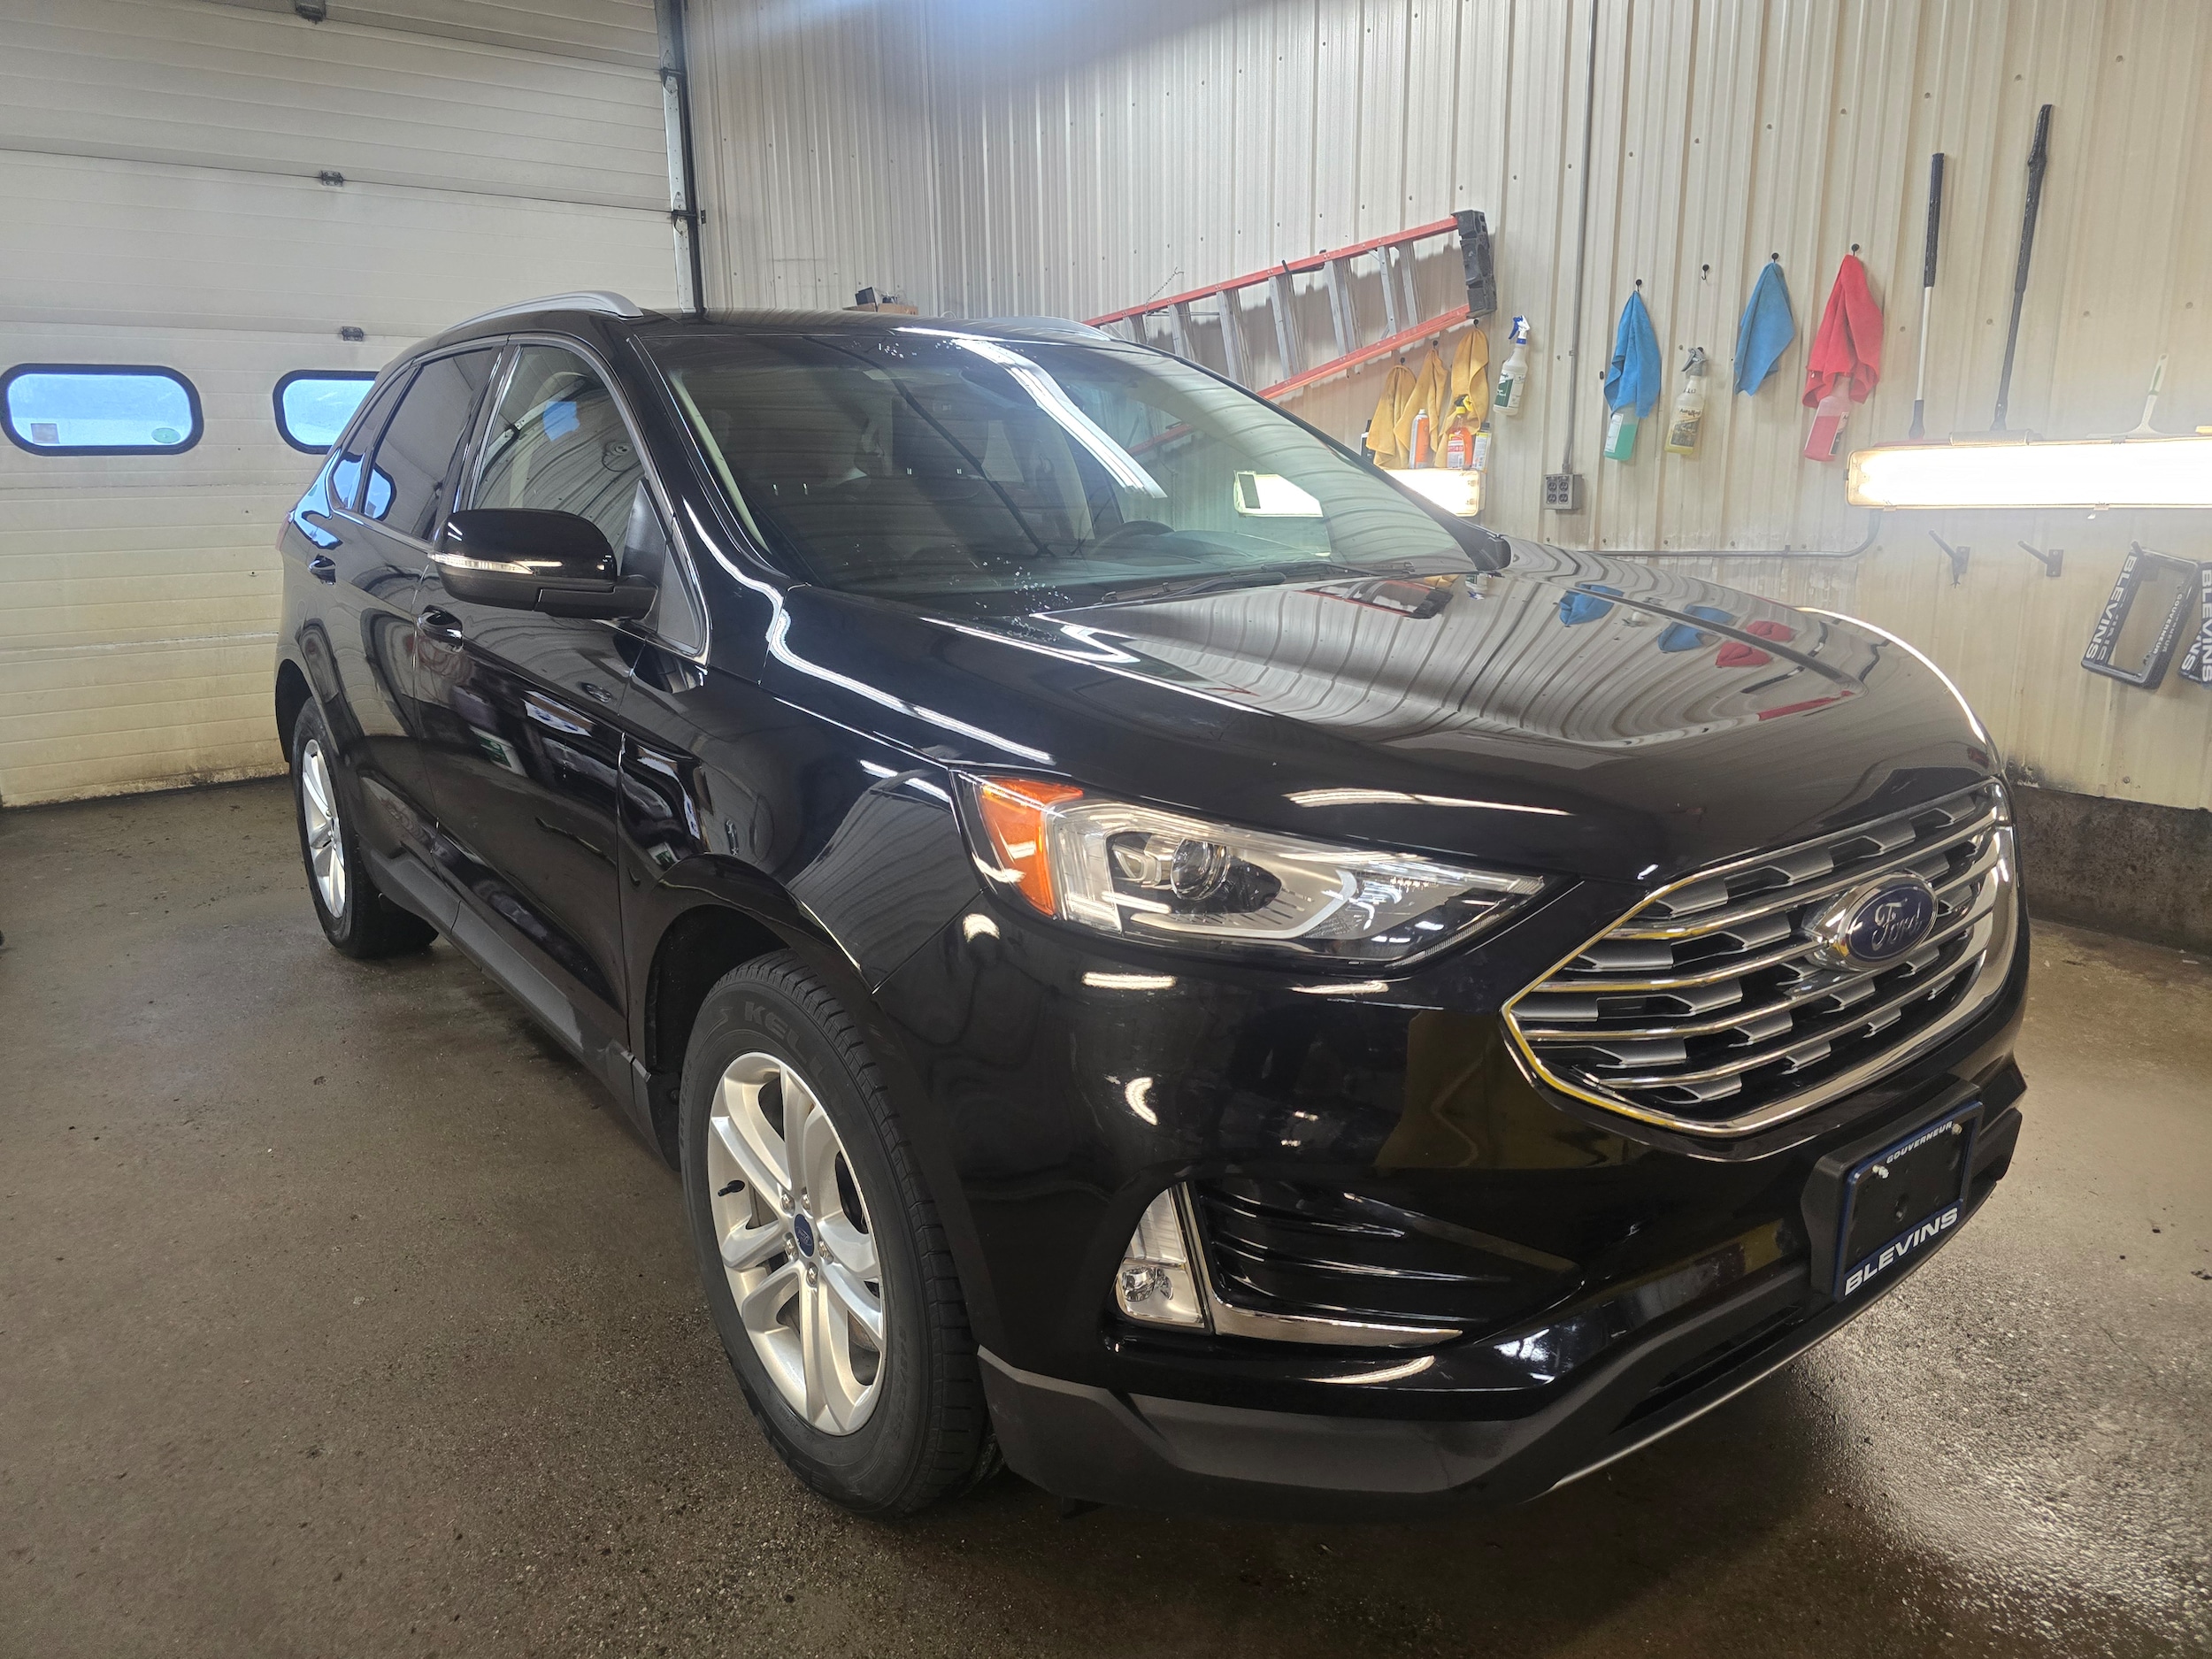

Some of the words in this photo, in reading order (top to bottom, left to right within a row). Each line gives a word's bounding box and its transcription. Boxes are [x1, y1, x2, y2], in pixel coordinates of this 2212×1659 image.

[2085, 555, 2138, 659] BLEVINS
[2153, 593, 2183, 655] GOUVERNEUR
[1870, 896, 1924, 952] Ford
[1886, 1120, 1954, 1164] GOUVERNEUR
[1844, 1207, 1958, 1296] BLEVINS
